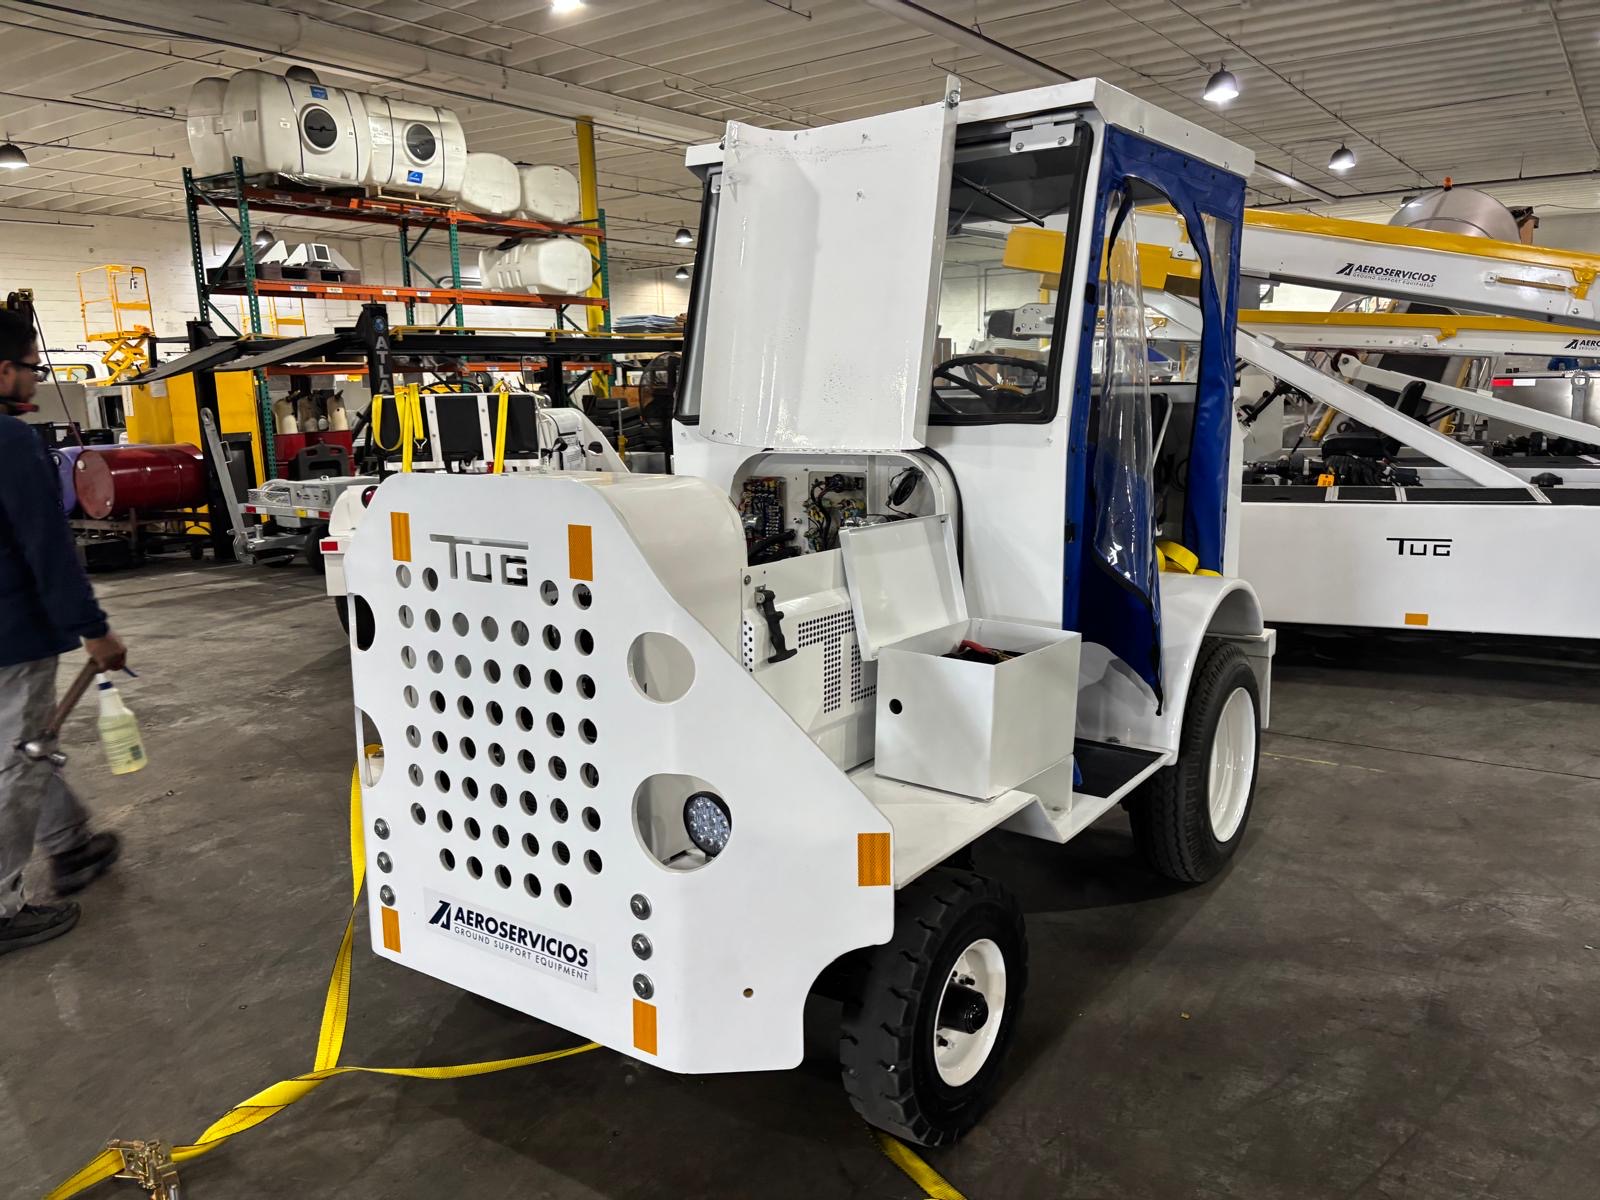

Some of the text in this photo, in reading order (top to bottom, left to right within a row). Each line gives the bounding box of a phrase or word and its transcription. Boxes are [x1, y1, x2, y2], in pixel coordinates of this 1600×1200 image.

[1354, 264, 1437, 283] AEROSERVICIOS
[429, 534, 528, 587] TUG
[1386, 537, 1452, 556] TUG
[454, 907, 588, 967] AEROSERVICIOS
[454, 926, 589, 981] GROUND SUPPORT EQUIPMENT
